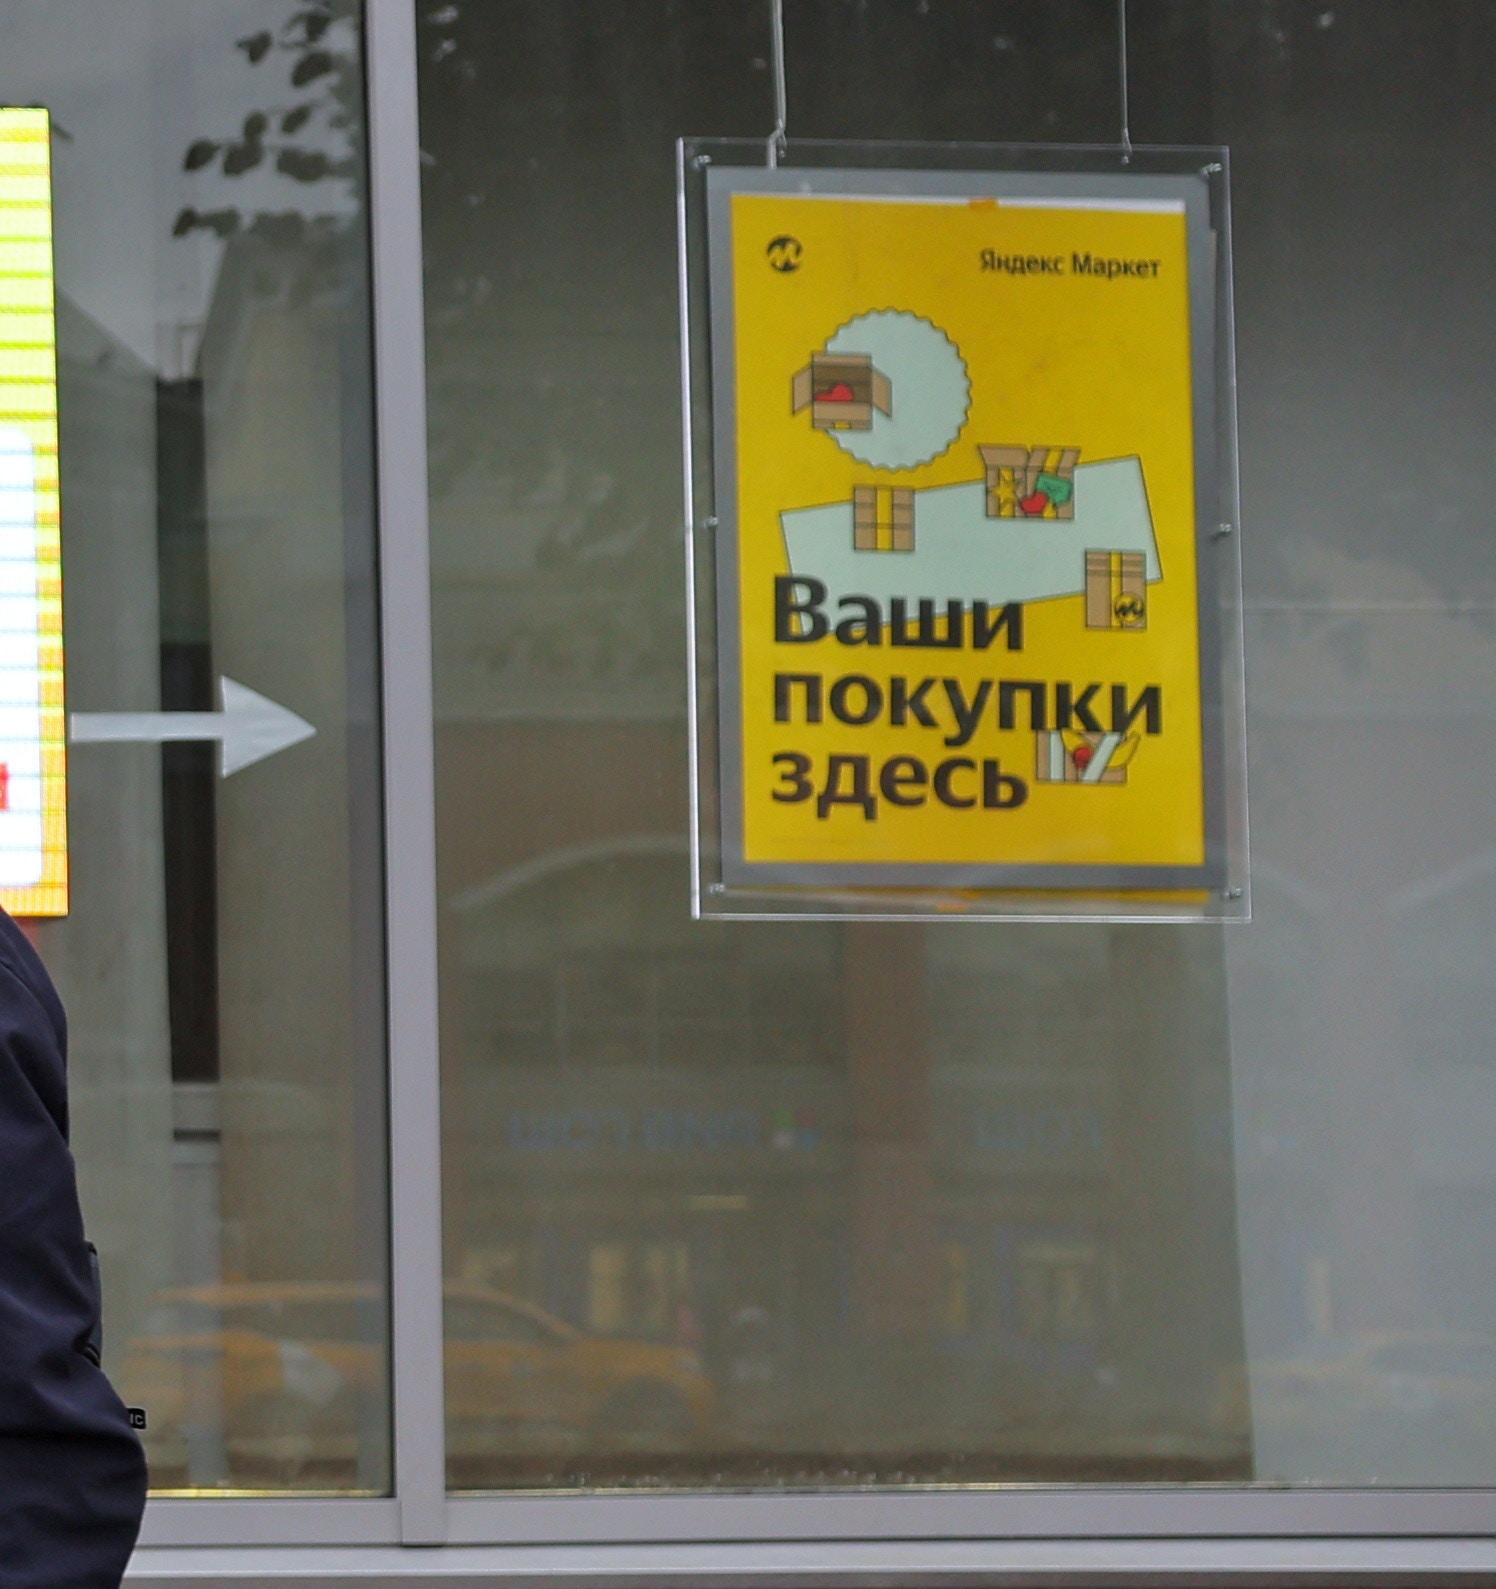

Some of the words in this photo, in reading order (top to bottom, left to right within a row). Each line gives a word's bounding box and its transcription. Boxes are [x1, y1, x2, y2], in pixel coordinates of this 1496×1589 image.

[979, 248, 1065, 276] Яндекс
[1072, 252, 1162, 281] Маркет
[774, 574, 1025, 652] Ваши
[773, 669, 1163, 747] покупки
[771, 750, 1029, 823] здесь
